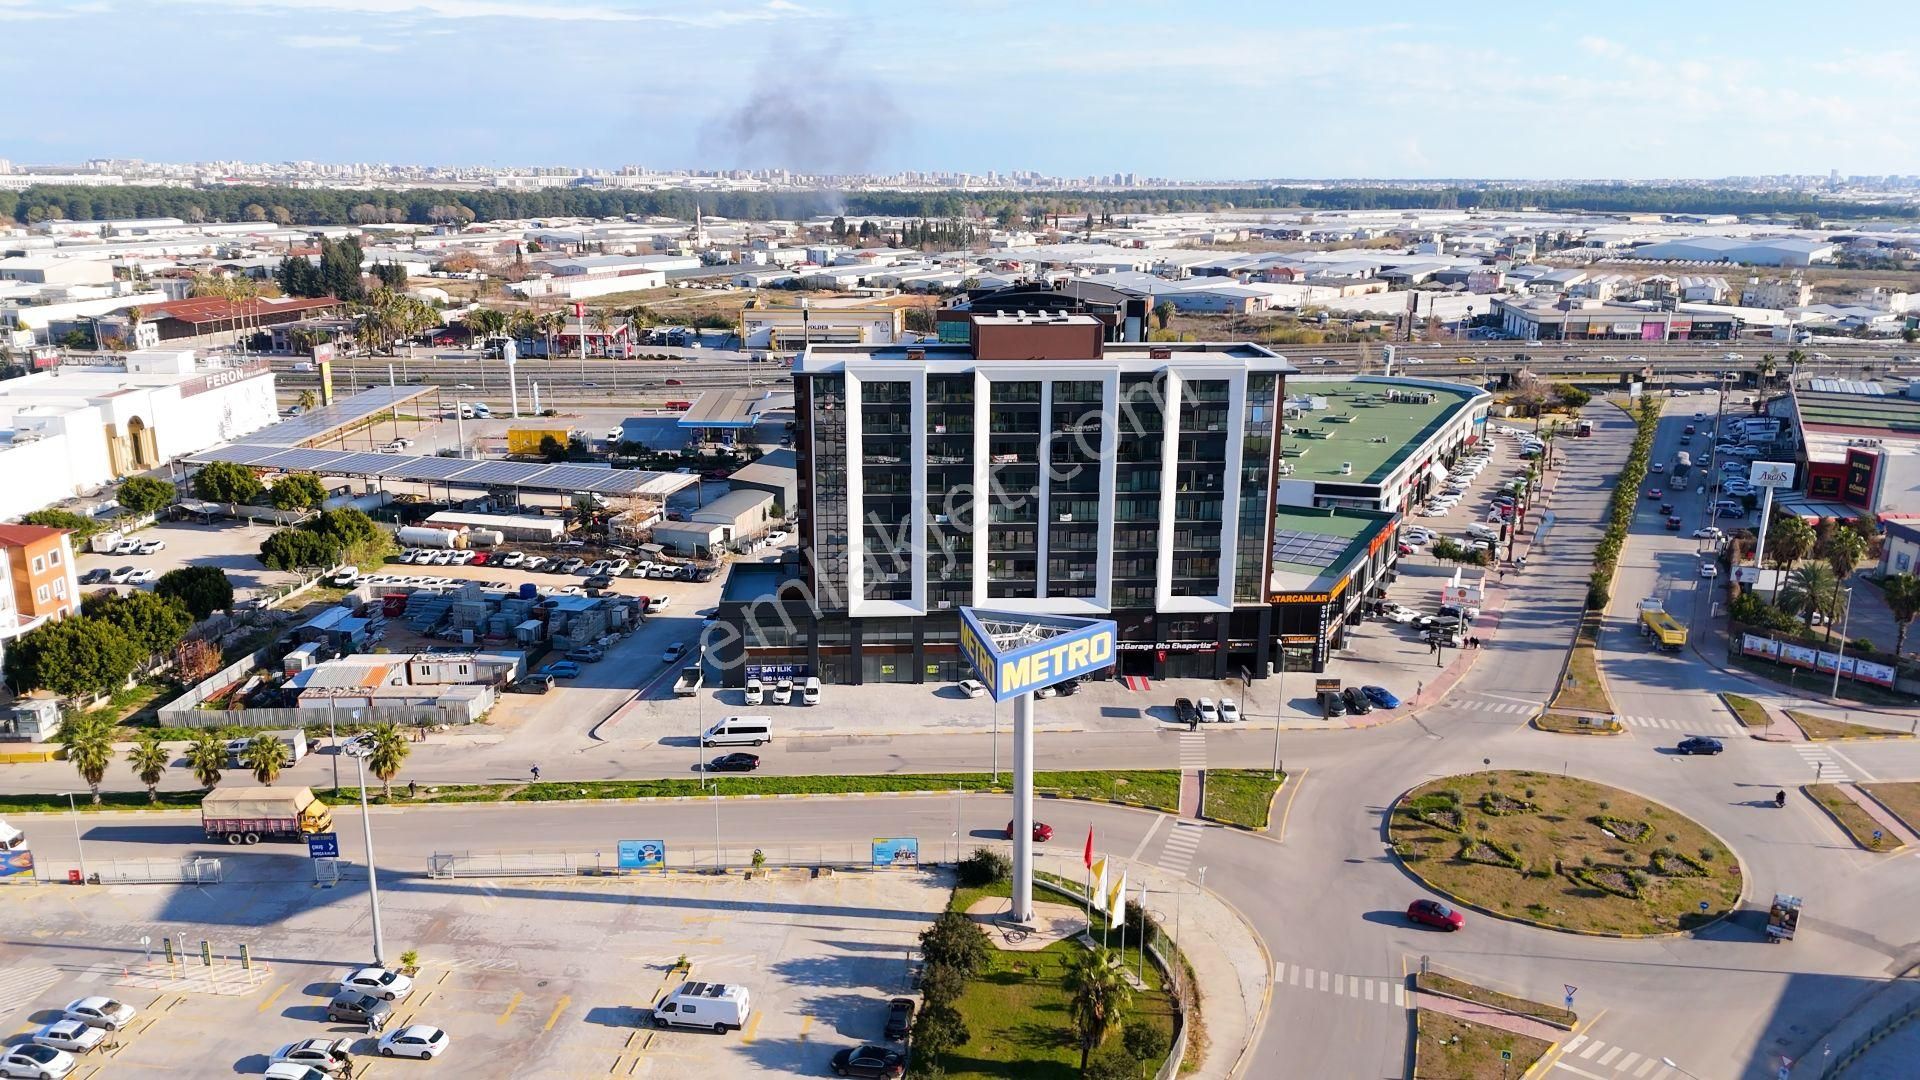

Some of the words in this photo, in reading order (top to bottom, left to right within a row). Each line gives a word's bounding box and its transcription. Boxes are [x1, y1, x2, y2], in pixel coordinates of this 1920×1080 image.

[206, 368, 244, 388] FERON
[1275, 594, 1328, 603] TARCANLAR
[960, 616, 995, 688] METRO
[1002, 631, 1112, 693] METRO
